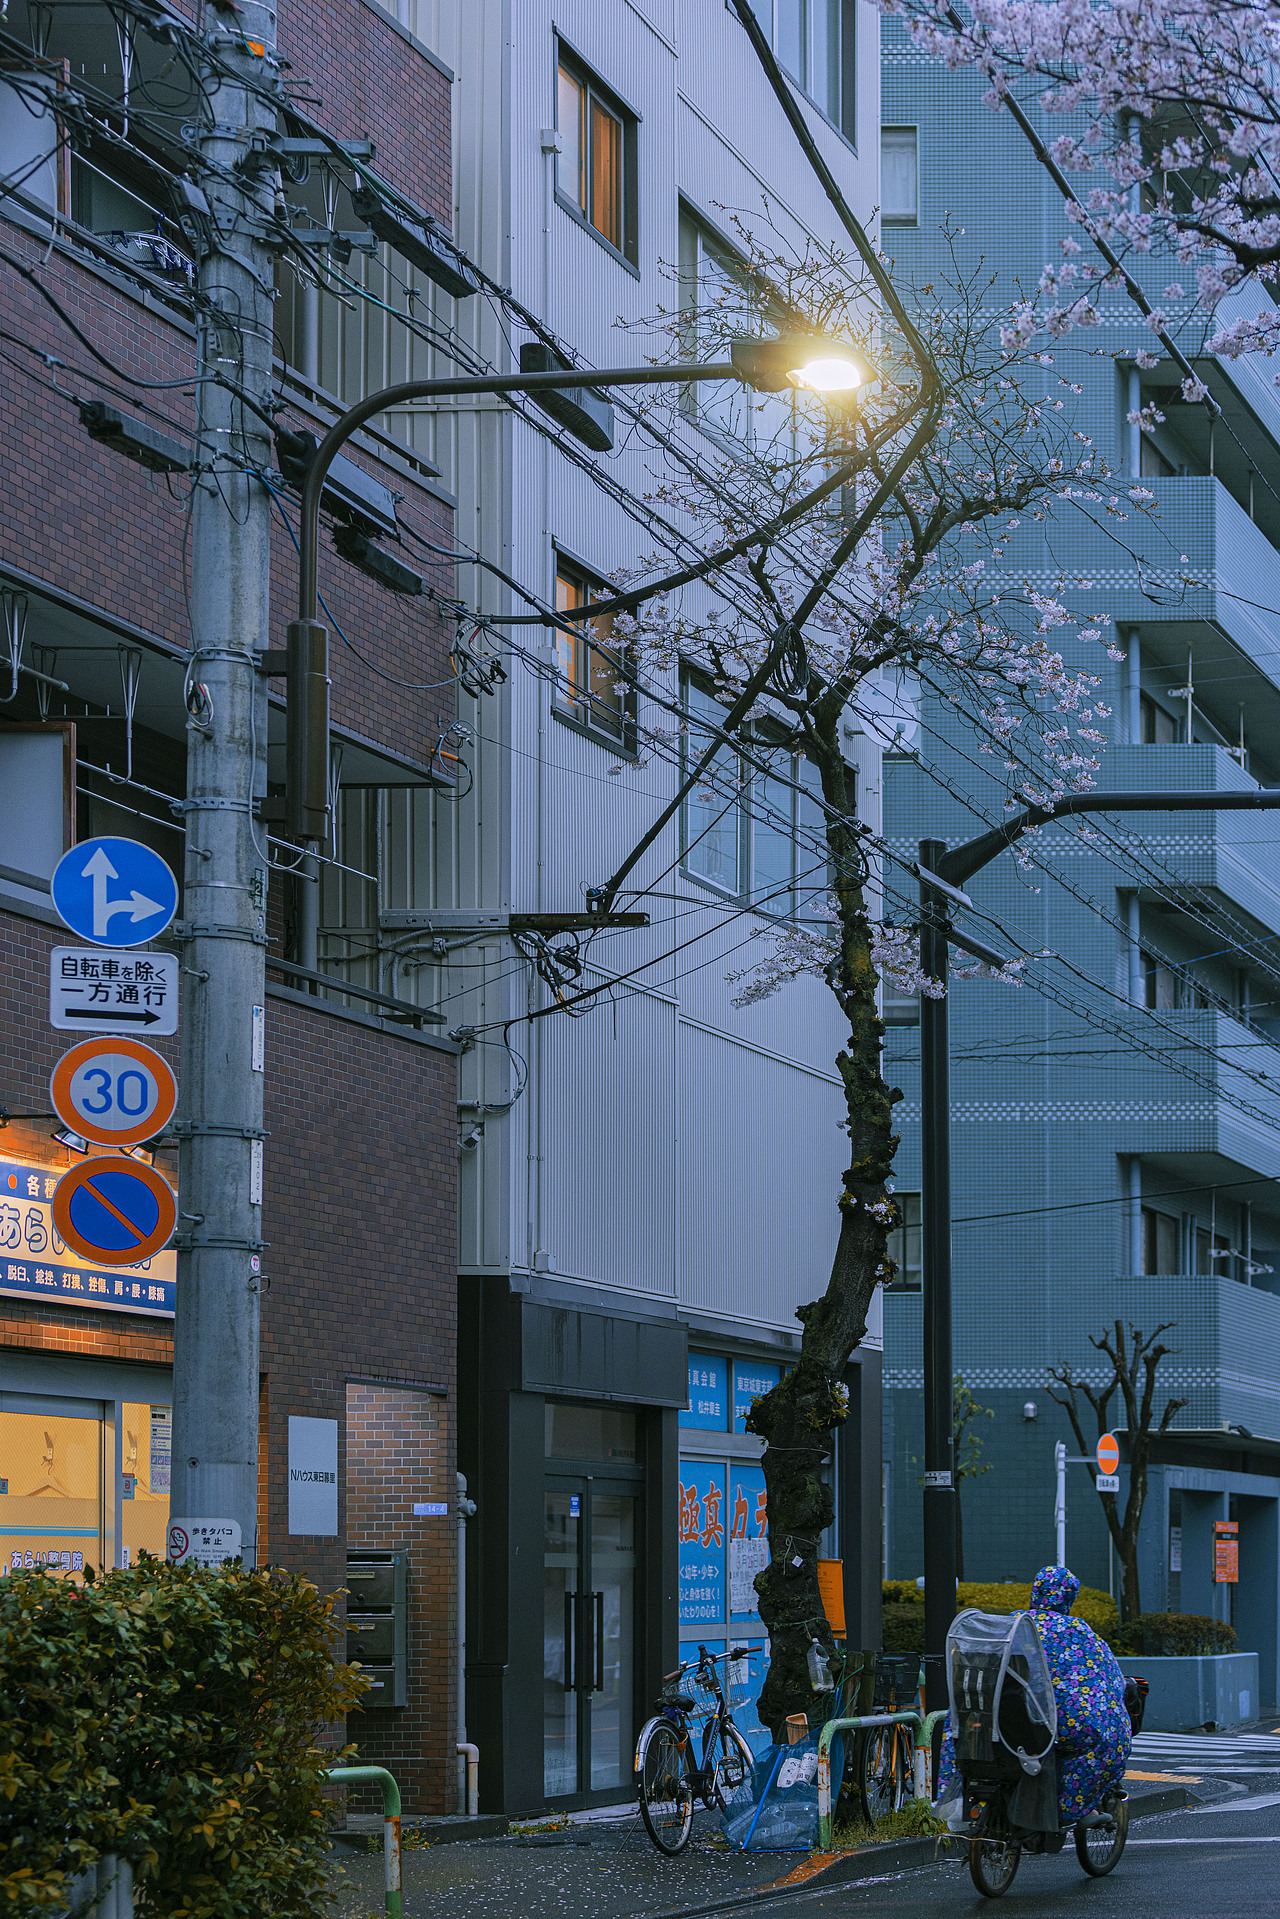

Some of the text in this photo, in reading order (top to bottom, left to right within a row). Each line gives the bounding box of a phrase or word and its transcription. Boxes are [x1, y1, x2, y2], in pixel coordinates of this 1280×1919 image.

[61, 956, 167, 982] 自転車を除く
[60, 982, 167, 1006] 一方通行
[82, 1068, 148, 1116] 30
[688, 1369, 717, 1389] 真会館
[290, 1469, 336, 1484] Nハウス東日暮里
[192, 1527, 233, 1536] 歩きタバコ
[203, 1537, 222, 1545] 禁止
[11, 1550, 84, 1571] あらい整骨院
